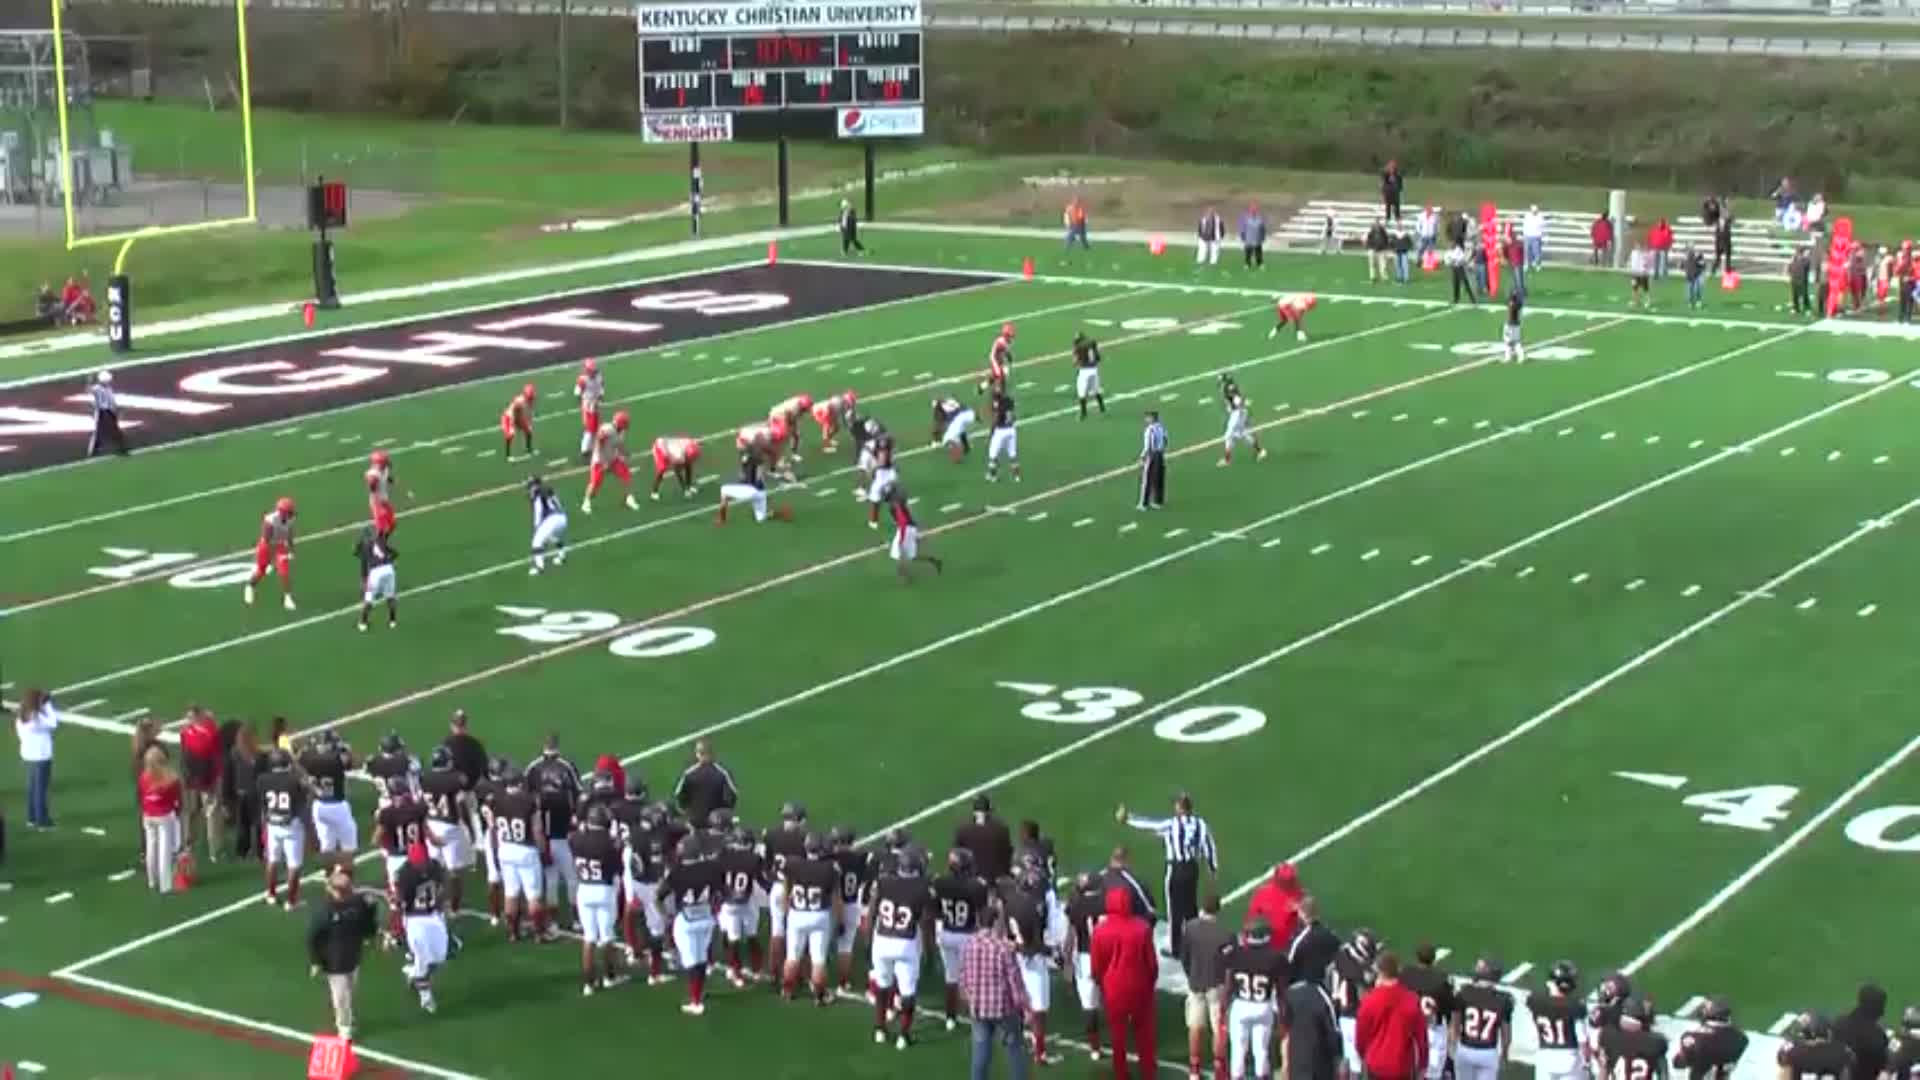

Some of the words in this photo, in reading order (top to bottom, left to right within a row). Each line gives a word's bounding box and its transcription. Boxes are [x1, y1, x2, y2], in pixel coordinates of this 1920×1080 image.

[641, 8, 728, 26] KENTUCKY
[735, 6, 821, 24] CHRISTIAN
[827, 5, 917, 21] UNIVERSITY
[494, 610, 718, 657] 20
[1020, 686, 1268, 743] 30
[878, 897, 912, 930] 93
[1233, 972, 1269, 1001] 35
[1464, 1005, 1498, 1041] 27
[1536, 1015, 1566, 1046] 31
